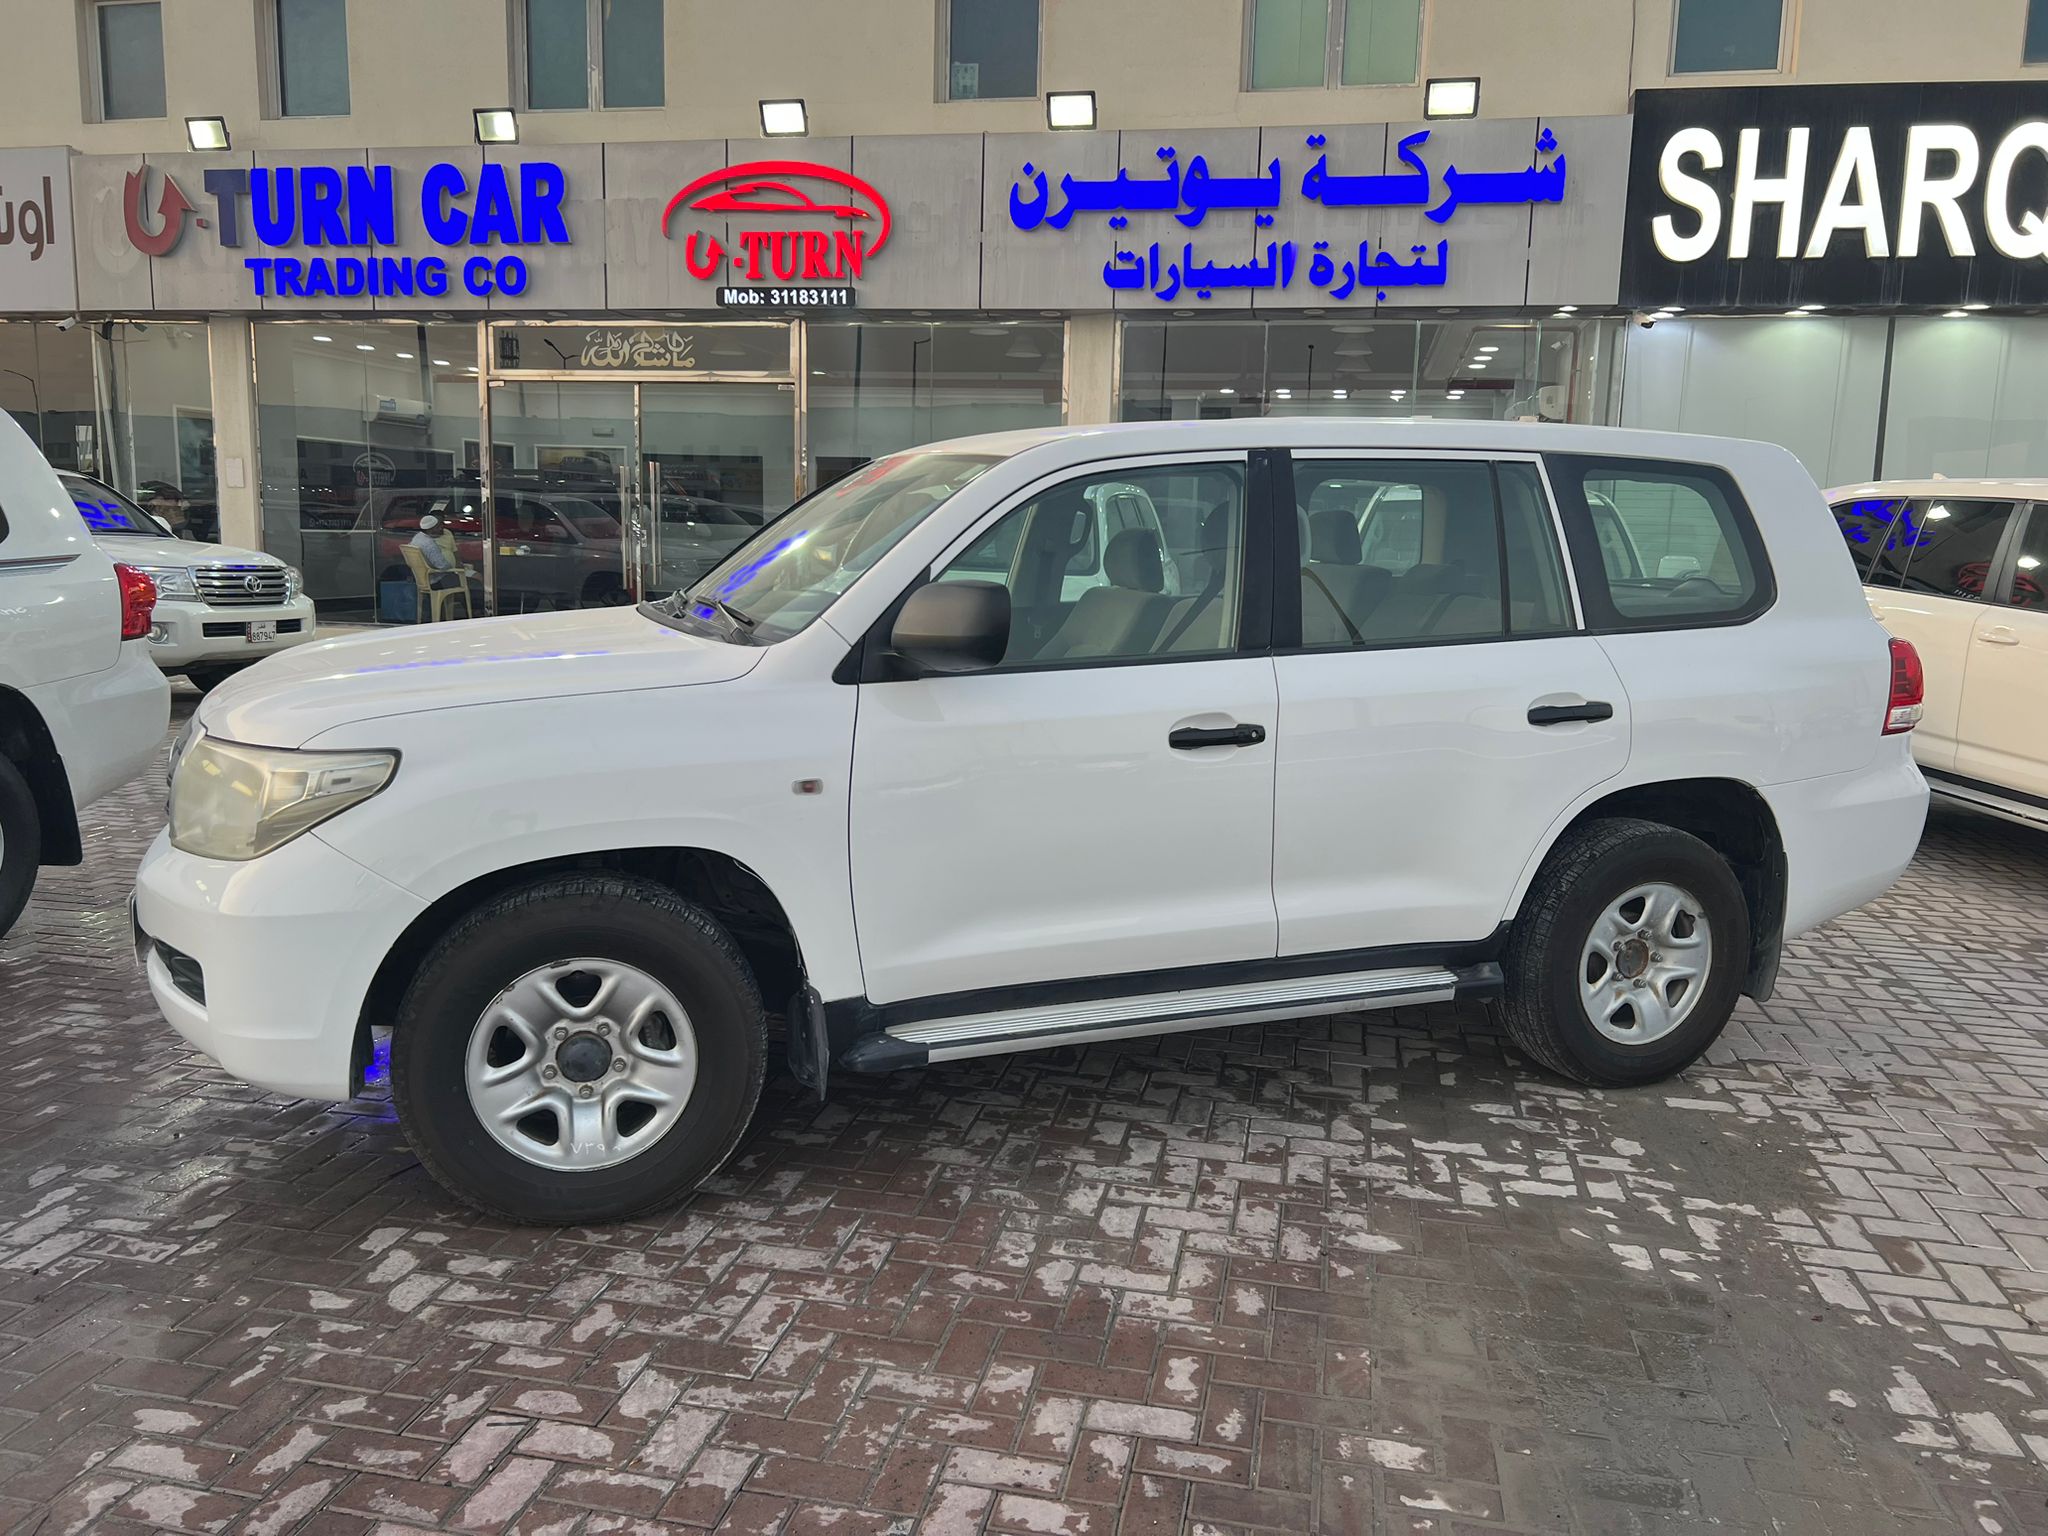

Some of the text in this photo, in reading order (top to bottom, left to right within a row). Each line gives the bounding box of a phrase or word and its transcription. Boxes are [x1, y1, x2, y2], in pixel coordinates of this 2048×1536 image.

[421, 162, 570, 246] CAR
[1009, 128, 1567, 232] شركة يوتيرن
[1653, 122, 2048, 262] SHARQ
[244, 255, 528, 298] TRADING CO
[723, 288, 848, 305] Mob: 31183111
[1102, 239, 1450, 303] لتجارة السيارات
